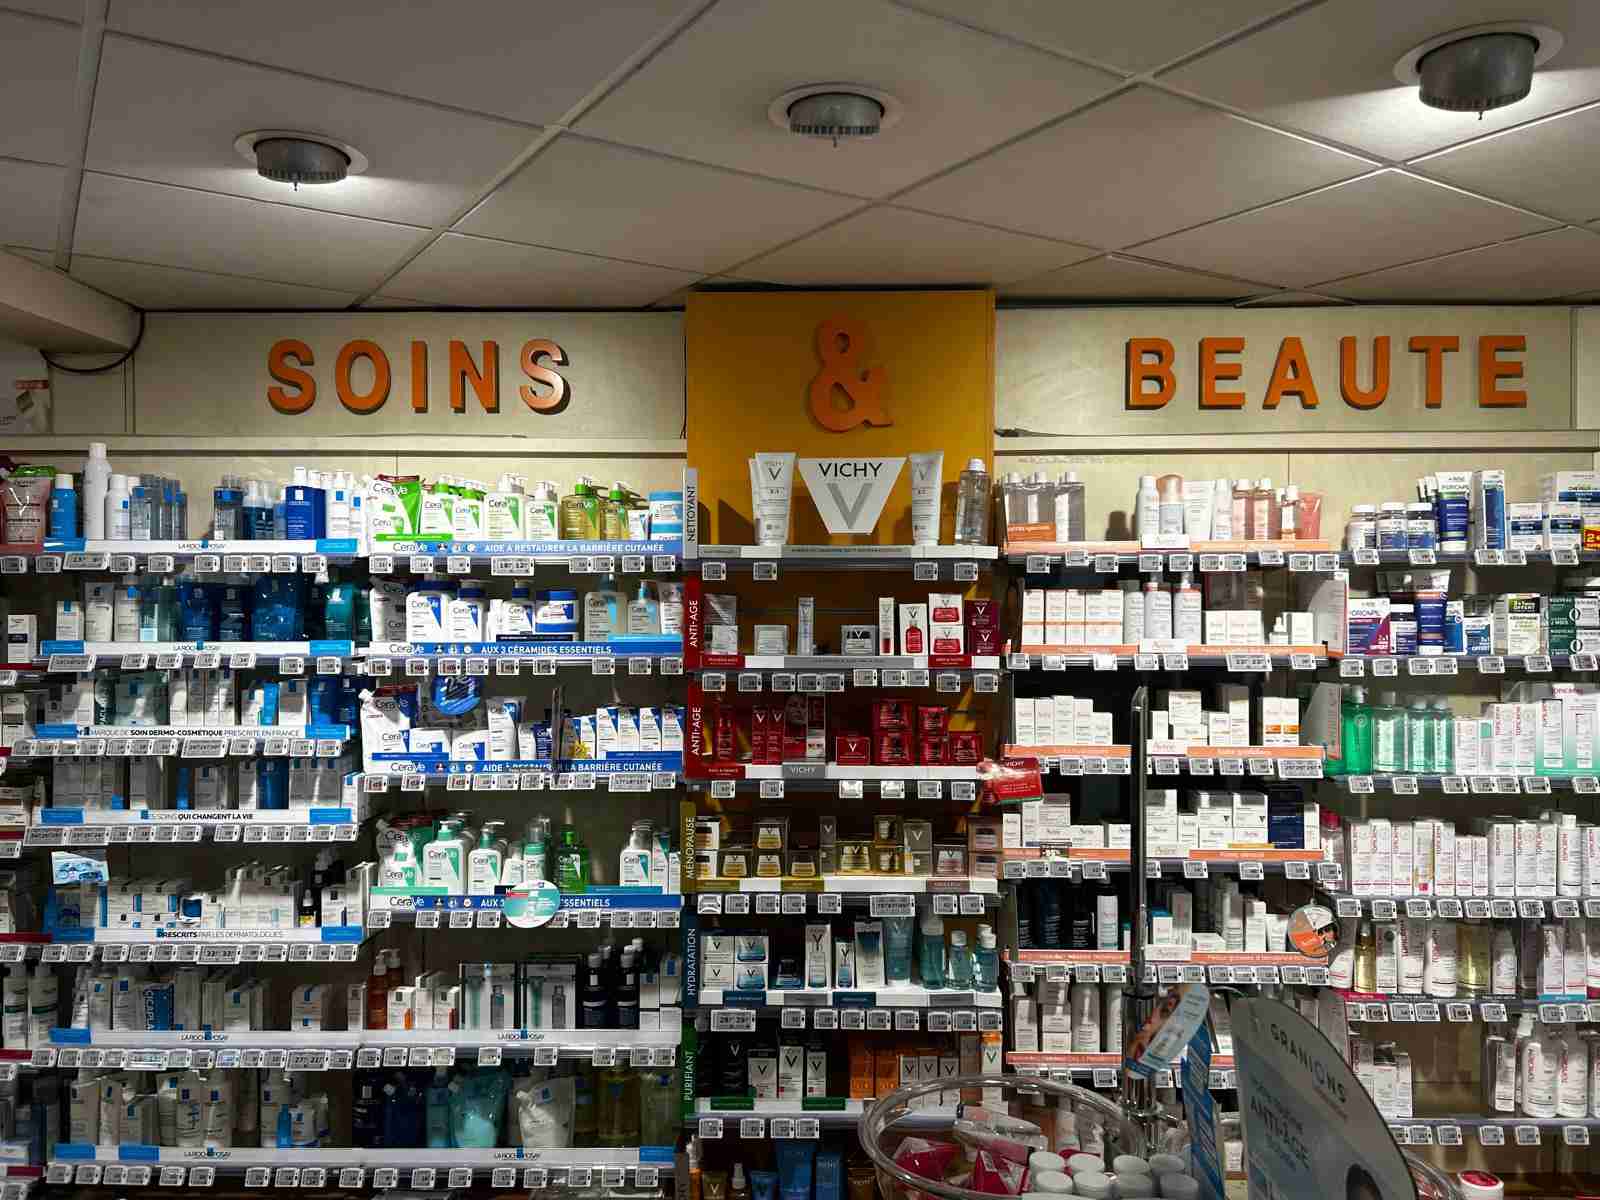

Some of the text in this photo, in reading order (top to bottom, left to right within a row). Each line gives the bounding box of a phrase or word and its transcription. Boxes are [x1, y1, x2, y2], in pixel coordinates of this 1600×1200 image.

[267, 318, 1528, 433] SOINS & BEAUTE
[818, 462, 883, 478] VICHY
[827, 483, 874, 529] V
[687, 486, 697, 542] NETTOYANT
[393, 541, 428, 553] CeraVe
[484, 543, 505, 552] AIDE
[514, 543, 565, 552] RESTAURER
[568, 543, 577, 552] LA
[580, 542, 624, 552] BARRIÈRE
[625, 542, 664, 552] CUTANÉE
[689, 599, 698, 648] ANTI-AGE
[389, 643, 424, 655] CeraVe
[481, 645, 499, 654] AUX
[501, 645, 506, 654] 3
[559, 645, 611, 654] ESSENTIELS
[130, 729, 148, 737] SOIN
[691, 707, 701, 756] ANTI-AGE
[390, 762, 426, 773] CeraVe
[483, 763, 503, 772] AIDE
[578, 761, 663, 772] BARRIÈRE CUTANÉE
[791, 766, 816, 775] VICHY
[178, 813, 191, 821] QUI
[390, 896, 424, 907] CeraVe
[481, 899, 497, 907] AUX
[560, 898, 610, 907] SSENTIELS
[687, 928, 696, 996] HYDRATATION
[1270, 1022, 1347, 1104] GRANIONS
[684, 1051, 695, 1101] PURIFIANT
